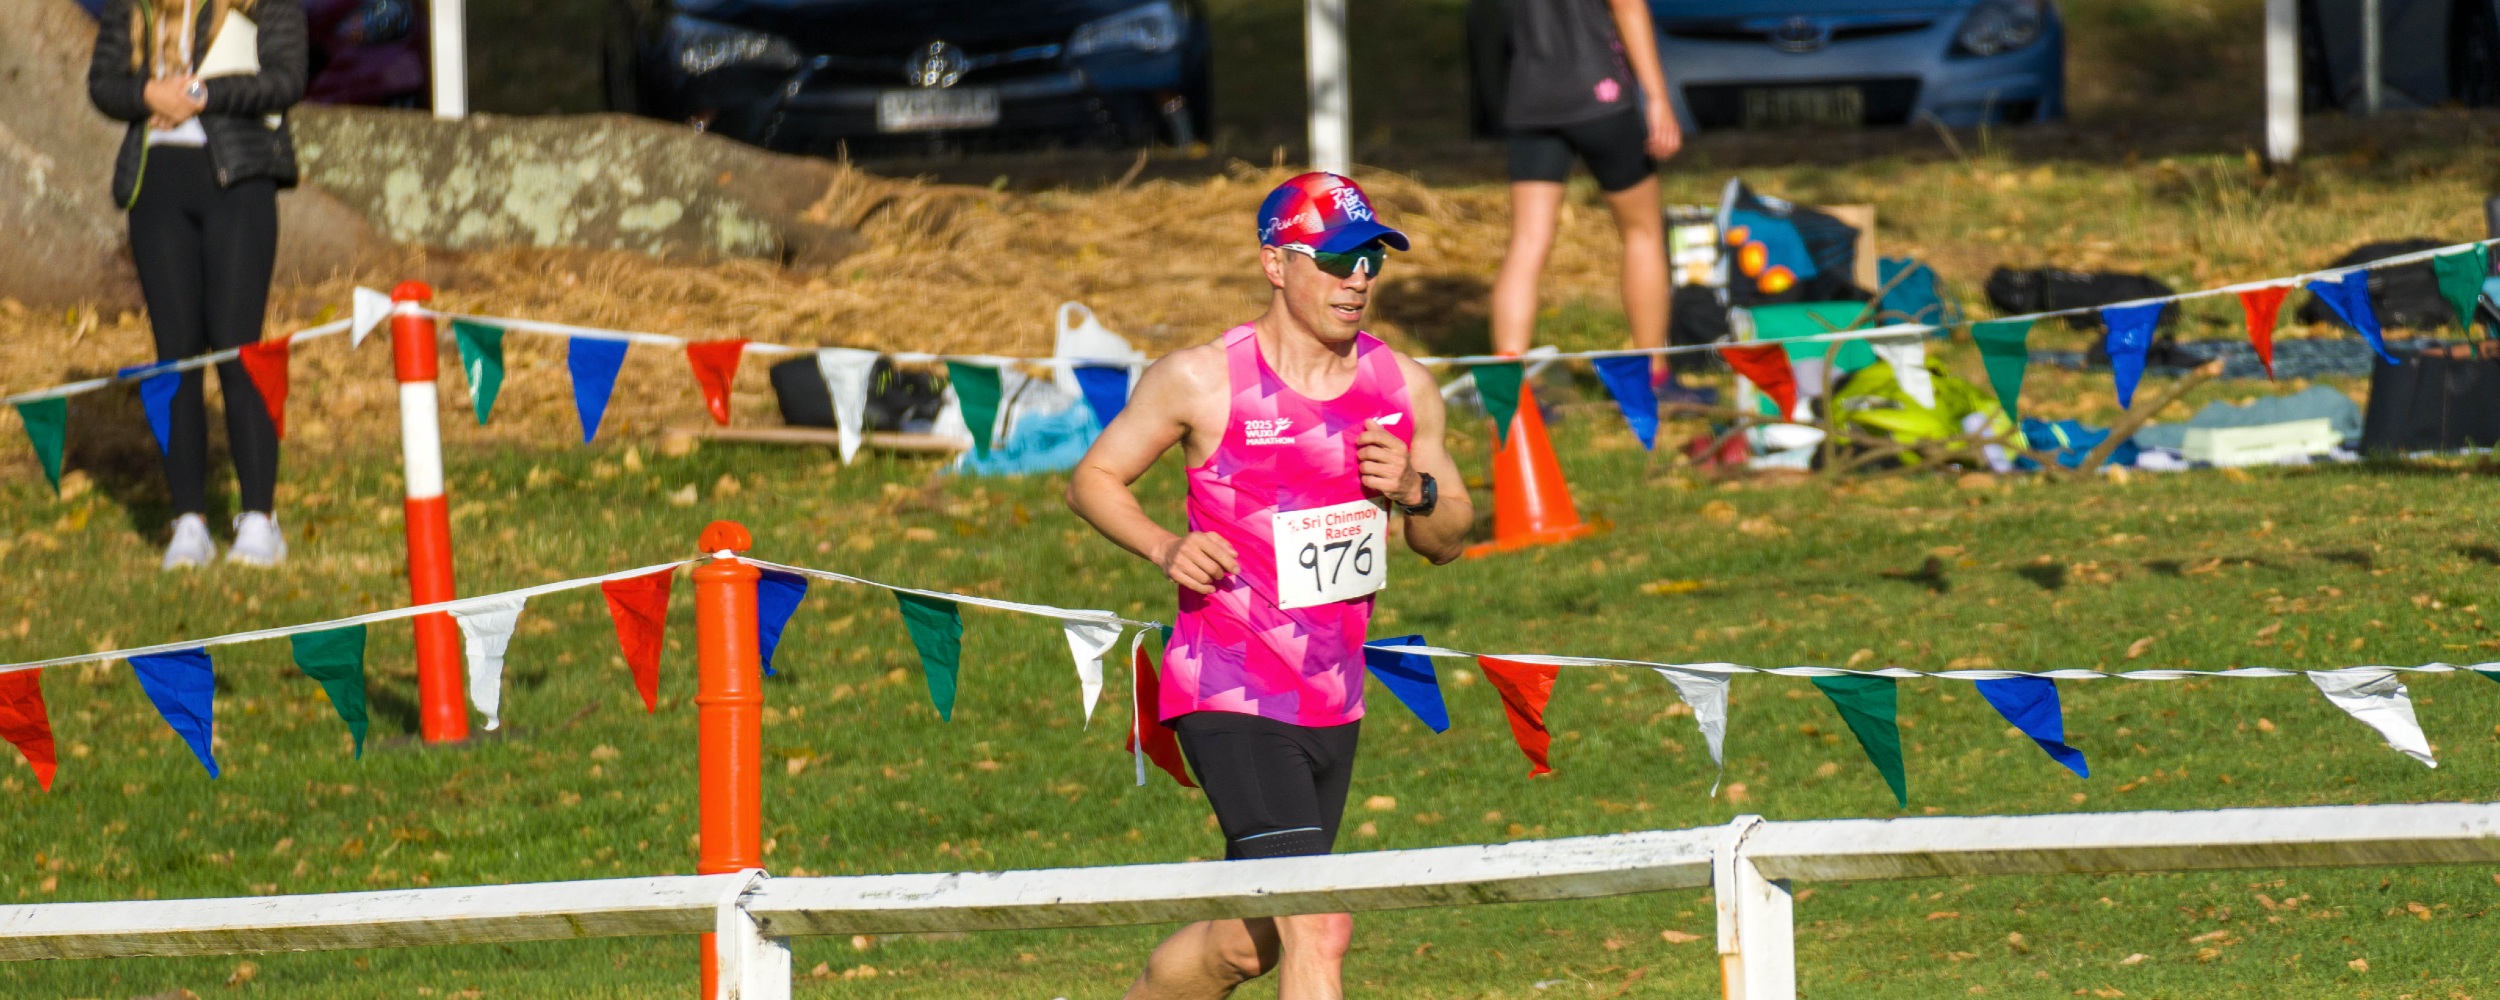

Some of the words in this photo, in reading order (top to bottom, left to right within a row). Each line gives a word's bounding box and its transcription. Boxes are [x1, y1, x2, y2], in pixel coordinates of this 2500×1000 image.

[1244, 420, 1273, 430] 2025
[1245, 429, 1274, 438] WUXI
[1245, 437, 1295, 446] MARATHON
[1302, 515, 1321, 530] Sri
[1325, 507, 1378, 527] Chinmoy
[1325, 524, 1362, 540] Races
[1299, 533, 1373, 592] 976
